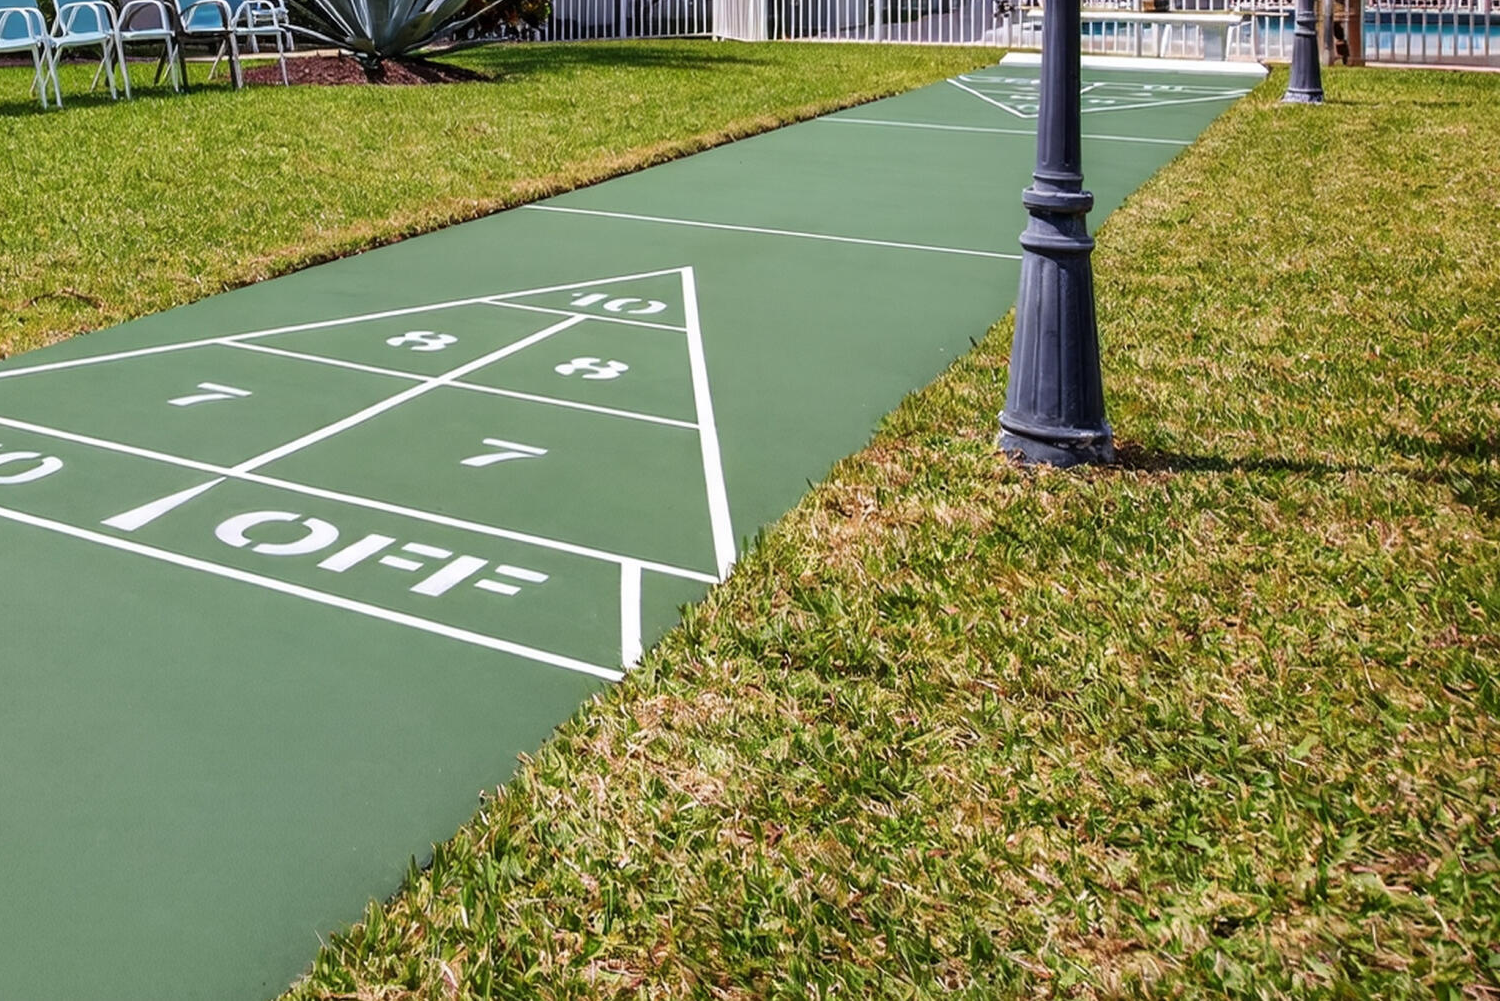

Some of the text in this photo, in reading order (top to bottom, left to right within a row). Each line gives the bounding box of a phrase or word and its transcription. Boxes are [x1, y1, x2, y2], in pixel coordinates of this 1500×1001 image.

[569, 291, 668, 315] 10
[384, 329, 459, 352] 8
[553, 356, 630, 381] 8
[167, 381, 253, 406] 7
[458, 436, 549, 468] 7
[213, 509, 550, 597] OFF
